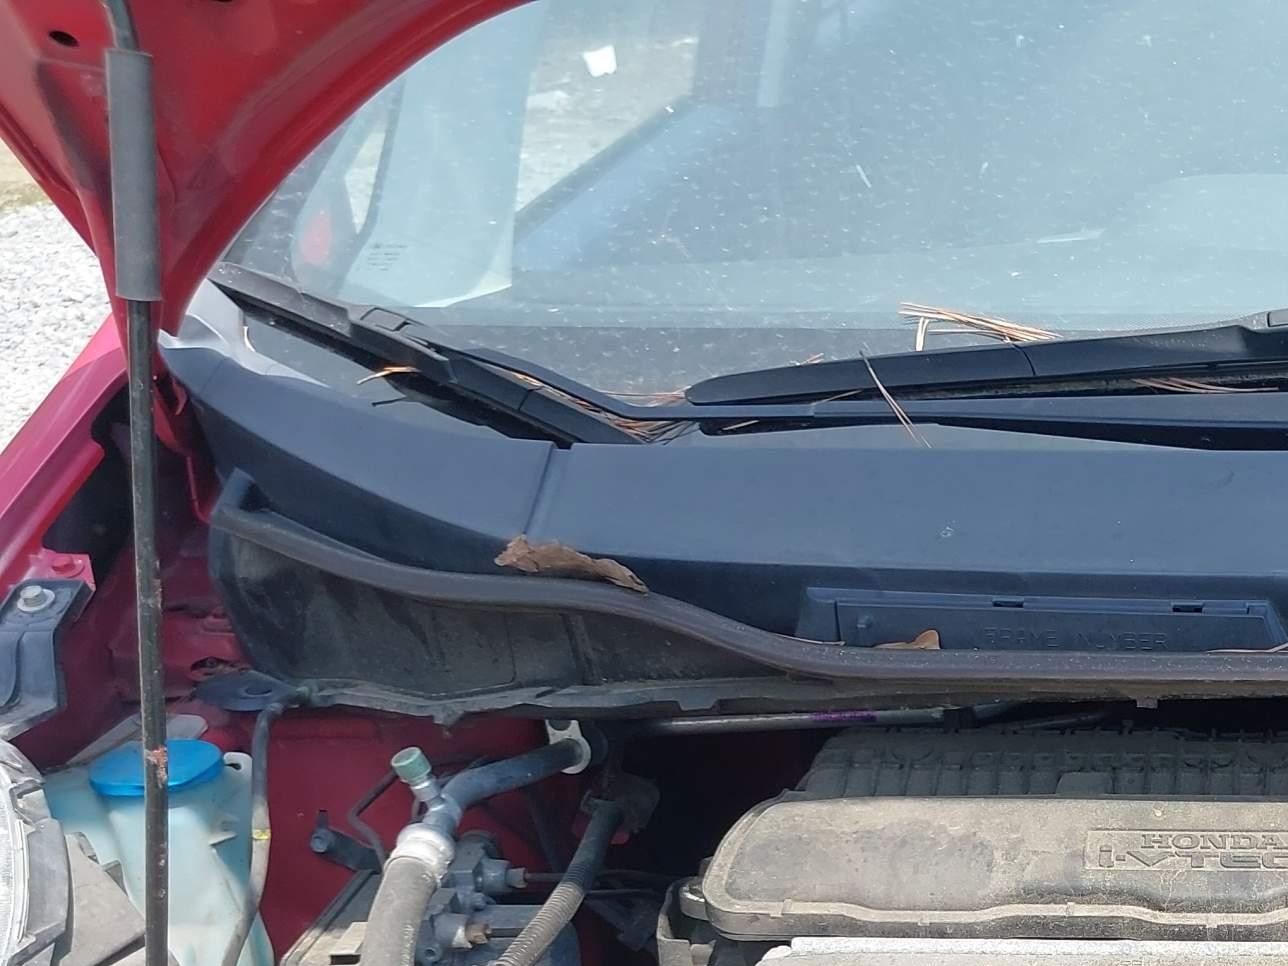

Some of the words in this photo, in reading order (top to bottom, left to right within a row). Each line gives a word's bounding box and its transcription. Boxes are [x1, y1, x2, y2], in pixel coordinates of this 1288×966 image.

[983, 627, 1059, 647] FRAME
[1077, 632, 1170, 650] NUMBER
[1140, 833, 1288, 850] HONDA
